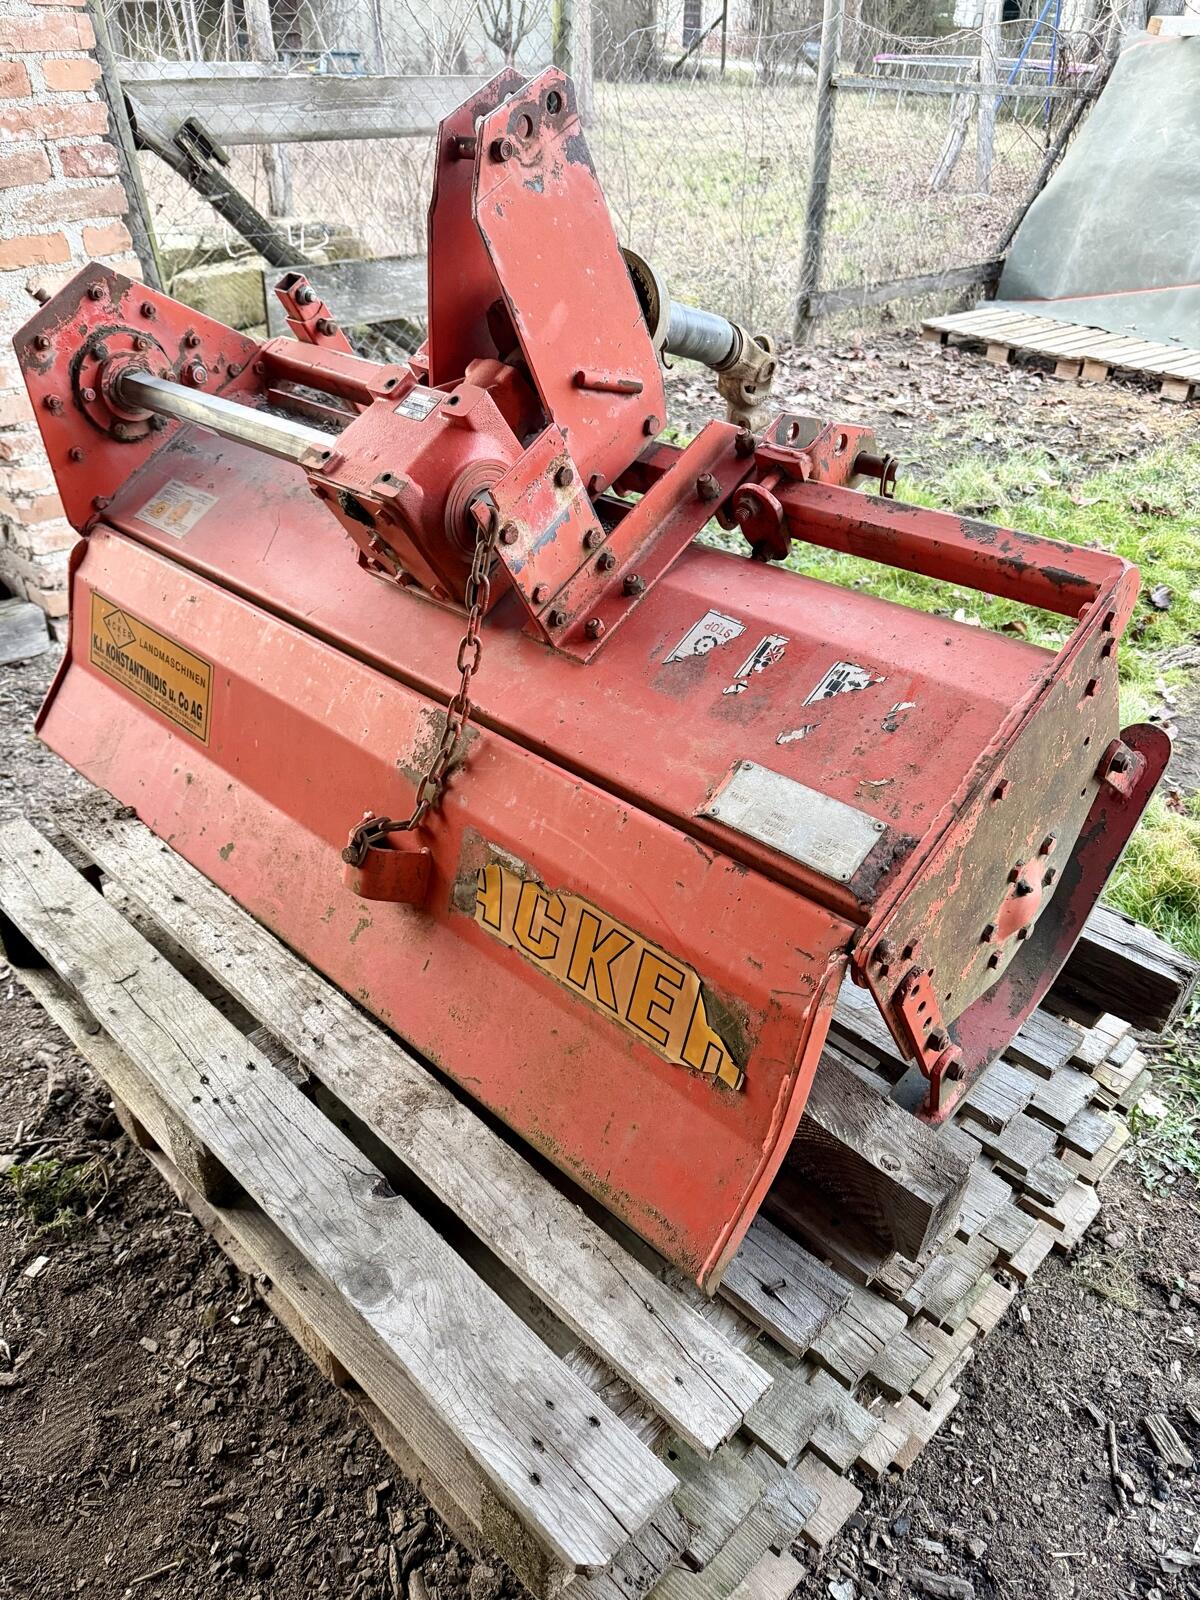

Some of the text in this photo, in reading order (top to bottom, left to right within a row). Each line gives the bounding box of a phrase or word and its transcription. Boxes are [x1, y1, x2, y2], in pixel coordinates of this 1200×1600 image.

[704, 621, 733, 639] STOP
[105, 641, 168, 696] KONSTANTINIDIS
[168, 688, 176, 702] u.
[178, 691, 189, 712] Co
[190, 701, 203, 721] AG
[139, 638, 206, 688] LANDMASCHINEN
